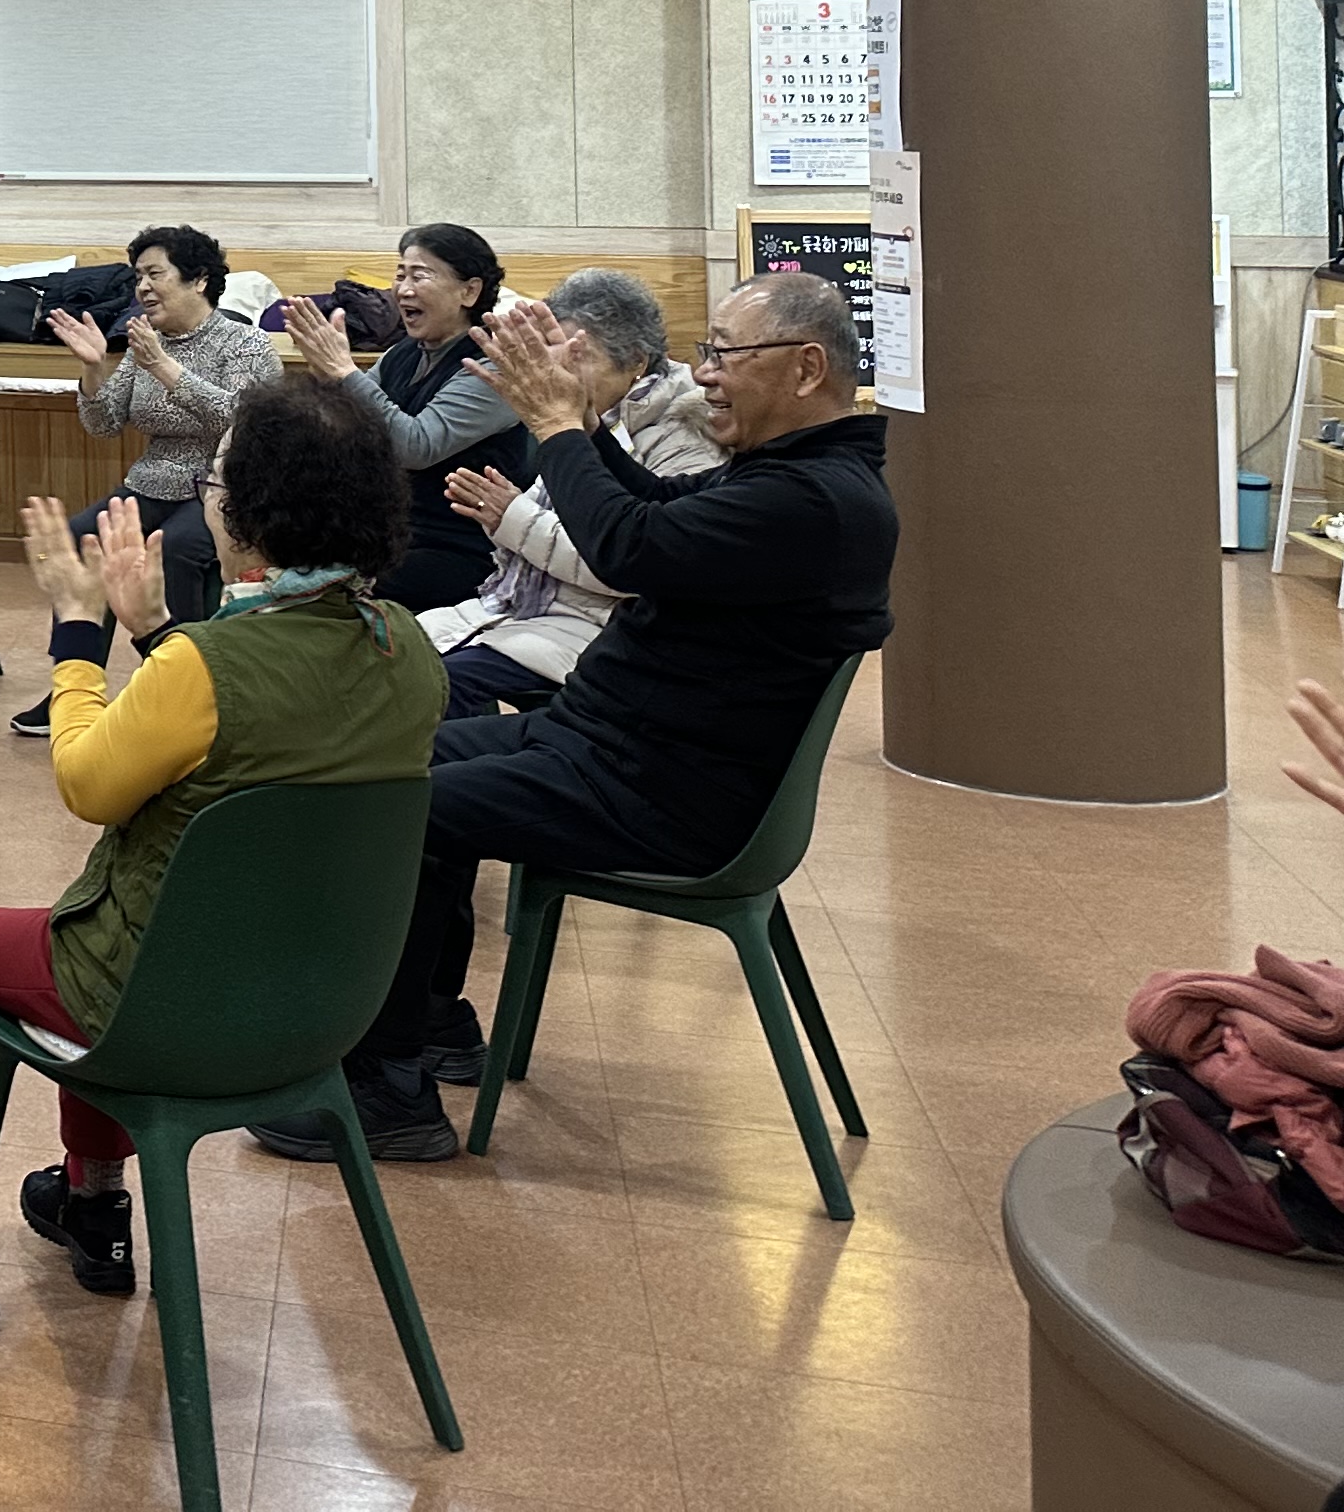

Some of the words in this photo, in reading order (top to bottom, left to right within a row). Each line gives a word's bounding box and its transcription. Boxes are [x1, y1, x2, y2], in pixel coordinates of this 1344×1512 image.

[817, 2, 831, 19] 3
[765, 54, 773, 65] 2
[784, 54, 792, 65] 3
[803, 54, 811, 65] 4
[822, 54, 830, 65] 5
[841, 54, 849, 65] 6
[860, 54, 868, 65] 7
[765, 74, 773, 85] 9
[781, 74, 795, 85] 10
[801, 74, 814, 85] 11
[820, 74, 833, 85] 12
[838, 74, 852, 85] 13
[762, 93, 777, 104] 16
[781, 93, 795, 104] 17
[801, 93, 815, 104] 18
[820, 93, 834, 104] 19
[838, 93, 854, 104] 20
[801, 113, 816, 124] 25
[820, 113, 835, 124] 26
[839, 113, 854, 124] 27
[840, 237, 870, 254] 카페
